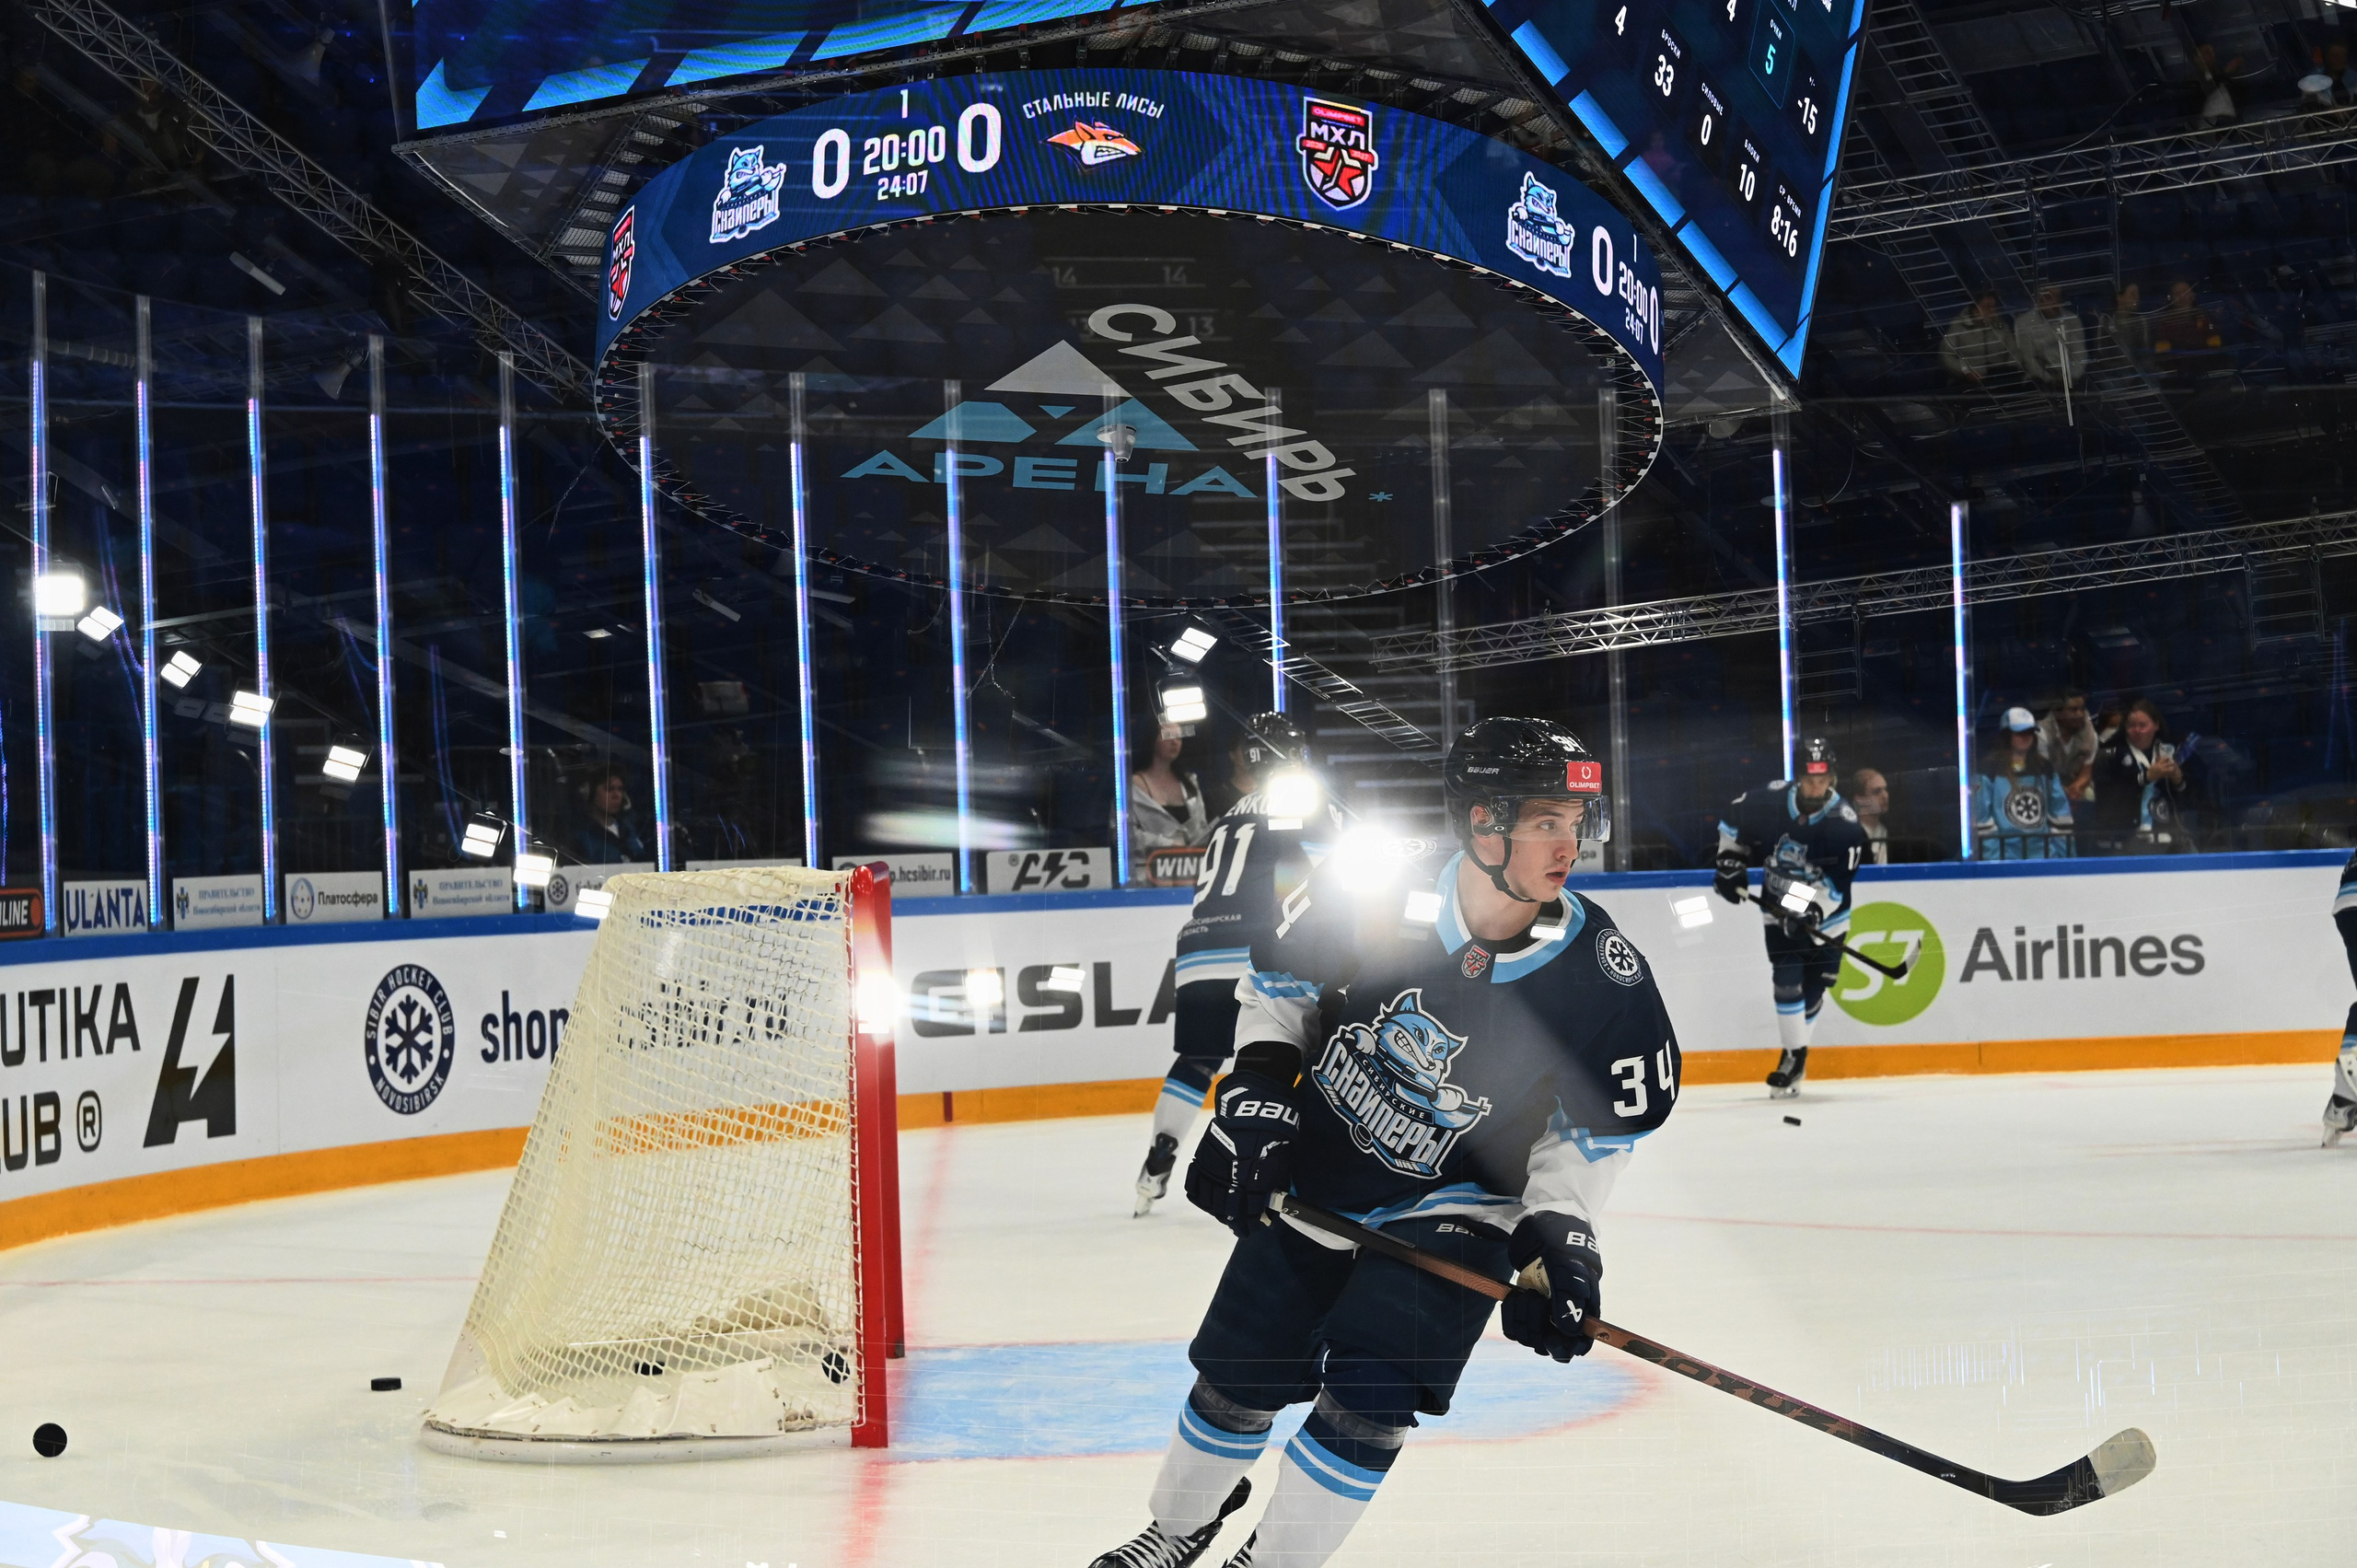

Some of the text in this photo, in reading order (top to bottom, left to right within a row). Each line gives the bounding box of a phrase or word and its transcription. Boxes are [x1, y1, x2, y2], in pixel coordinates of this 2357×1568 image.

[1614, 5, 1628, 37] 4
[1660, 29, 1681, 59] БРОСКИ
[1764, 43, 1776, 75] 5
[1655, 53, 1675, 97] 33
[900, 88, 910, 119] 1
[1022, 91, 1165, 120] СТАЛЬНЫЕ ЛИСЫ
[1701, 82, 1724, 116] СИЛОВЫЕ
[1797, 97, 1818, 134] -15
[957, 102, 1002, 173] 0
[1310, 122, 1366, 151] МХЛ
[1701, 114, 1713, 145] 0
[812, 128, 851, 200] 0
[863, 125, 946, 176] 20:00
[1744, 139, 1761, 164] БЛОКИ
[877, 169, 928, 202] 24:07
[1738, 164, 1756, 202] 10
[1771, 204, 1799, 258] 8:16
[1592, 226, 1614, 296] 0
[1619, 261, 1648, 324] 20:00
[1625, 307, 1644, 345] 24:07
[1649, 285, 1659, 355] 0
[1087, 303, 1357, 503] СИБИРЬ
[840, 449, 1259, 499] АРЕНА
[1248, 747, 1261, 763] 91
[1467, 766, 1500, 775] BAUER
[1155, 855, 1203, 878] WIN
[1192, 821, 1259, 906] 91
[65, 887, 145, 931] ULANTA
[318, 889, 379, 907] Платосфера
[1958, 923, 2207, 983] Airlines
[366, 966, 454, 1040] SIBIR HOCKEY CLUB
[0, 981, 142, 1068] UTIKA
[376, 1072, 445, 1113] NOVOSIBIRSK
[1362, 1059, 1425, 1119] СИБИРСКИЕ
[1610, 1040, 1676, 1118] 34
[0, 1090, 63, 1175] UB
[1234, 1099, 1301, 1132] BAU
